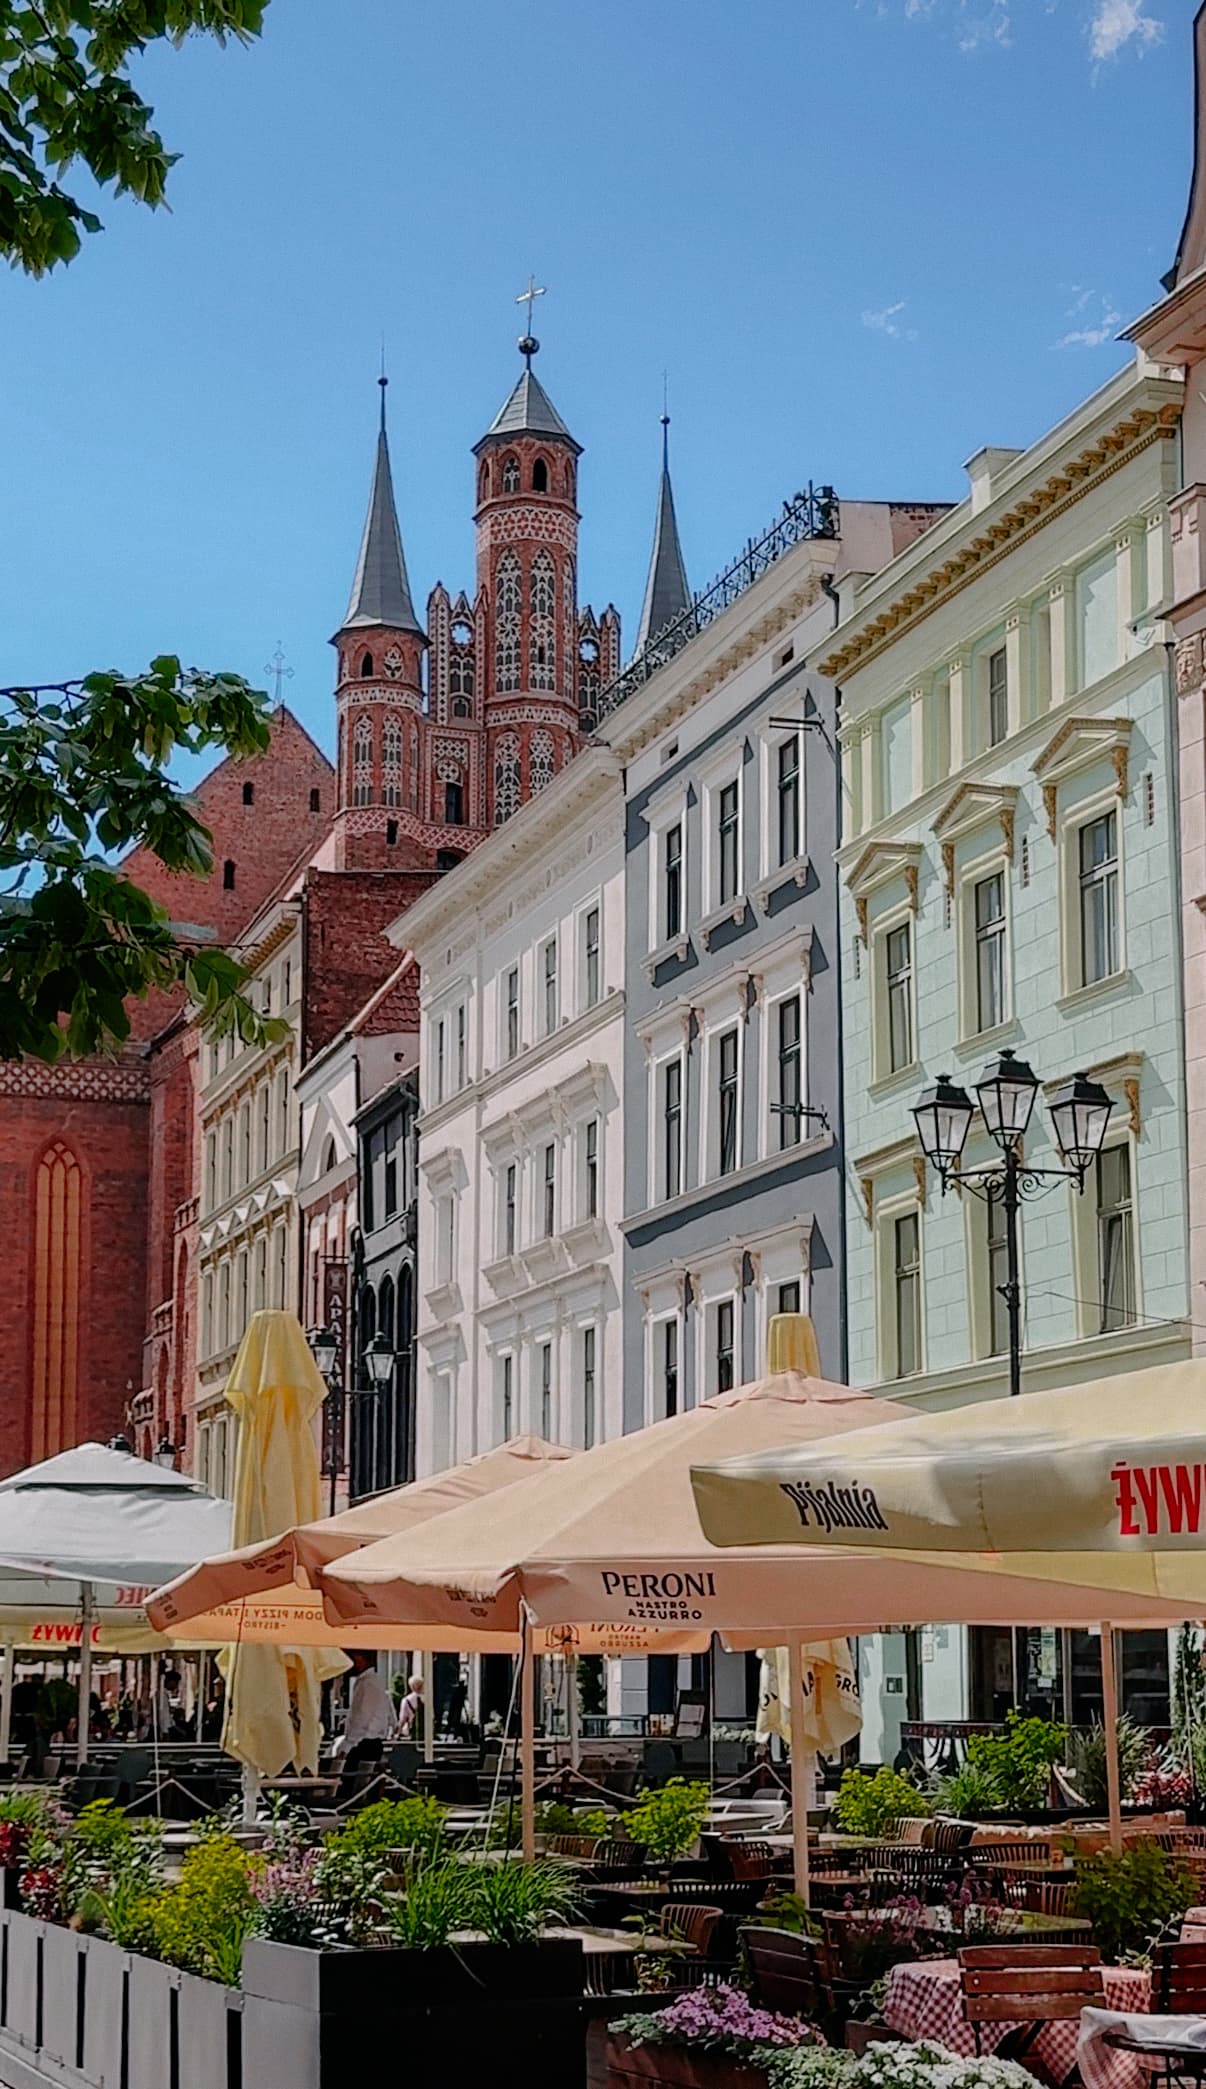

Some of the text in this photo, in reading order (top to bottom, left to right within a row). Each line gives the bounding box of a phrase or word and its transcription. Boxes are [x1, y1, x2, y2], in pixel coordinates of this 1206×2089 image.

[779, 1480, 888, 1533] Pijalnia
[1110, 1461, 1206, 1534] ŻYW
[601, 1571, 716, 1598] PERONI
[628, 1608, 702, 1620] AZZURRO
[636, 1601, 688, 1609] NASTRO
[32, 1623, 102, 1643] ŻYWIC
